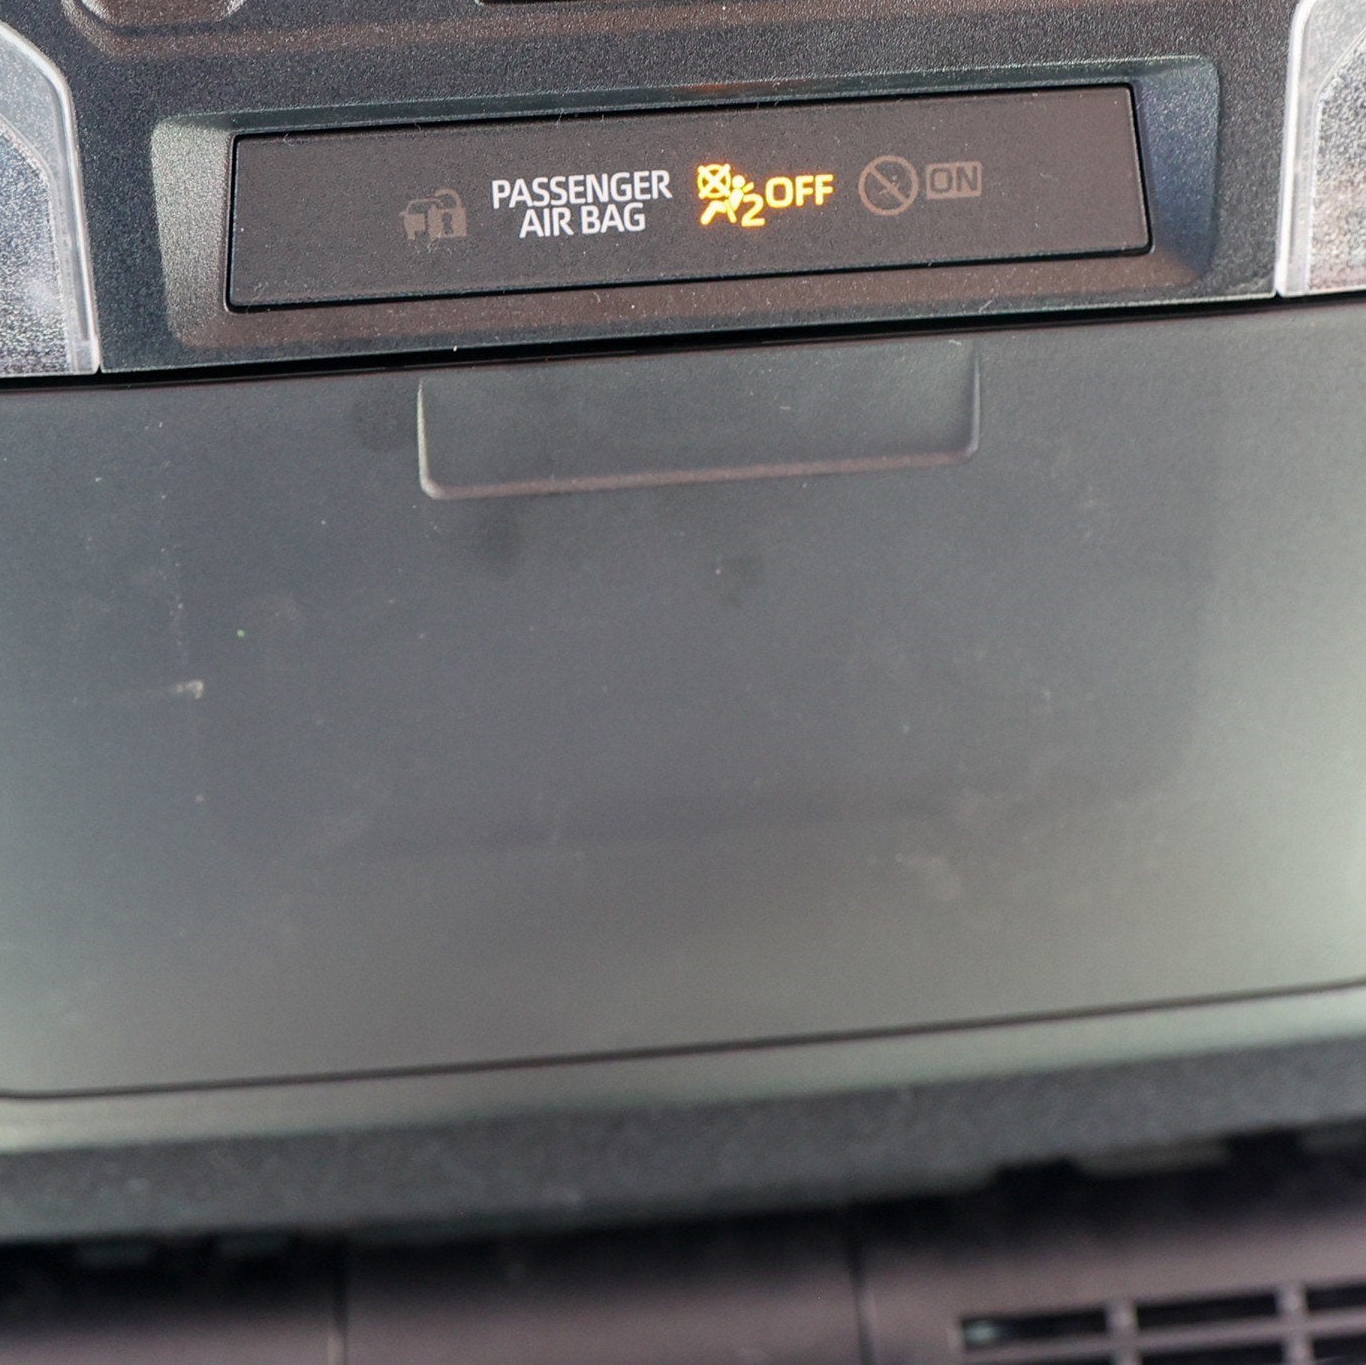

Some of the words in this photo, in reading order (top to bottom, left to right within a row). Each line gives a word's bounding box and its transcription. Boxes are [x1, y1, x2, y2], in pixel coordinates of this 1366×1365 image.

[491, 169, 673, 209] PASSENGER
[765, 174, 834, 208] OFF
[930, 165, 978, 193] ON
[519, 207, 574, 239] AIR
[580, 202, 647, 235] BAG
